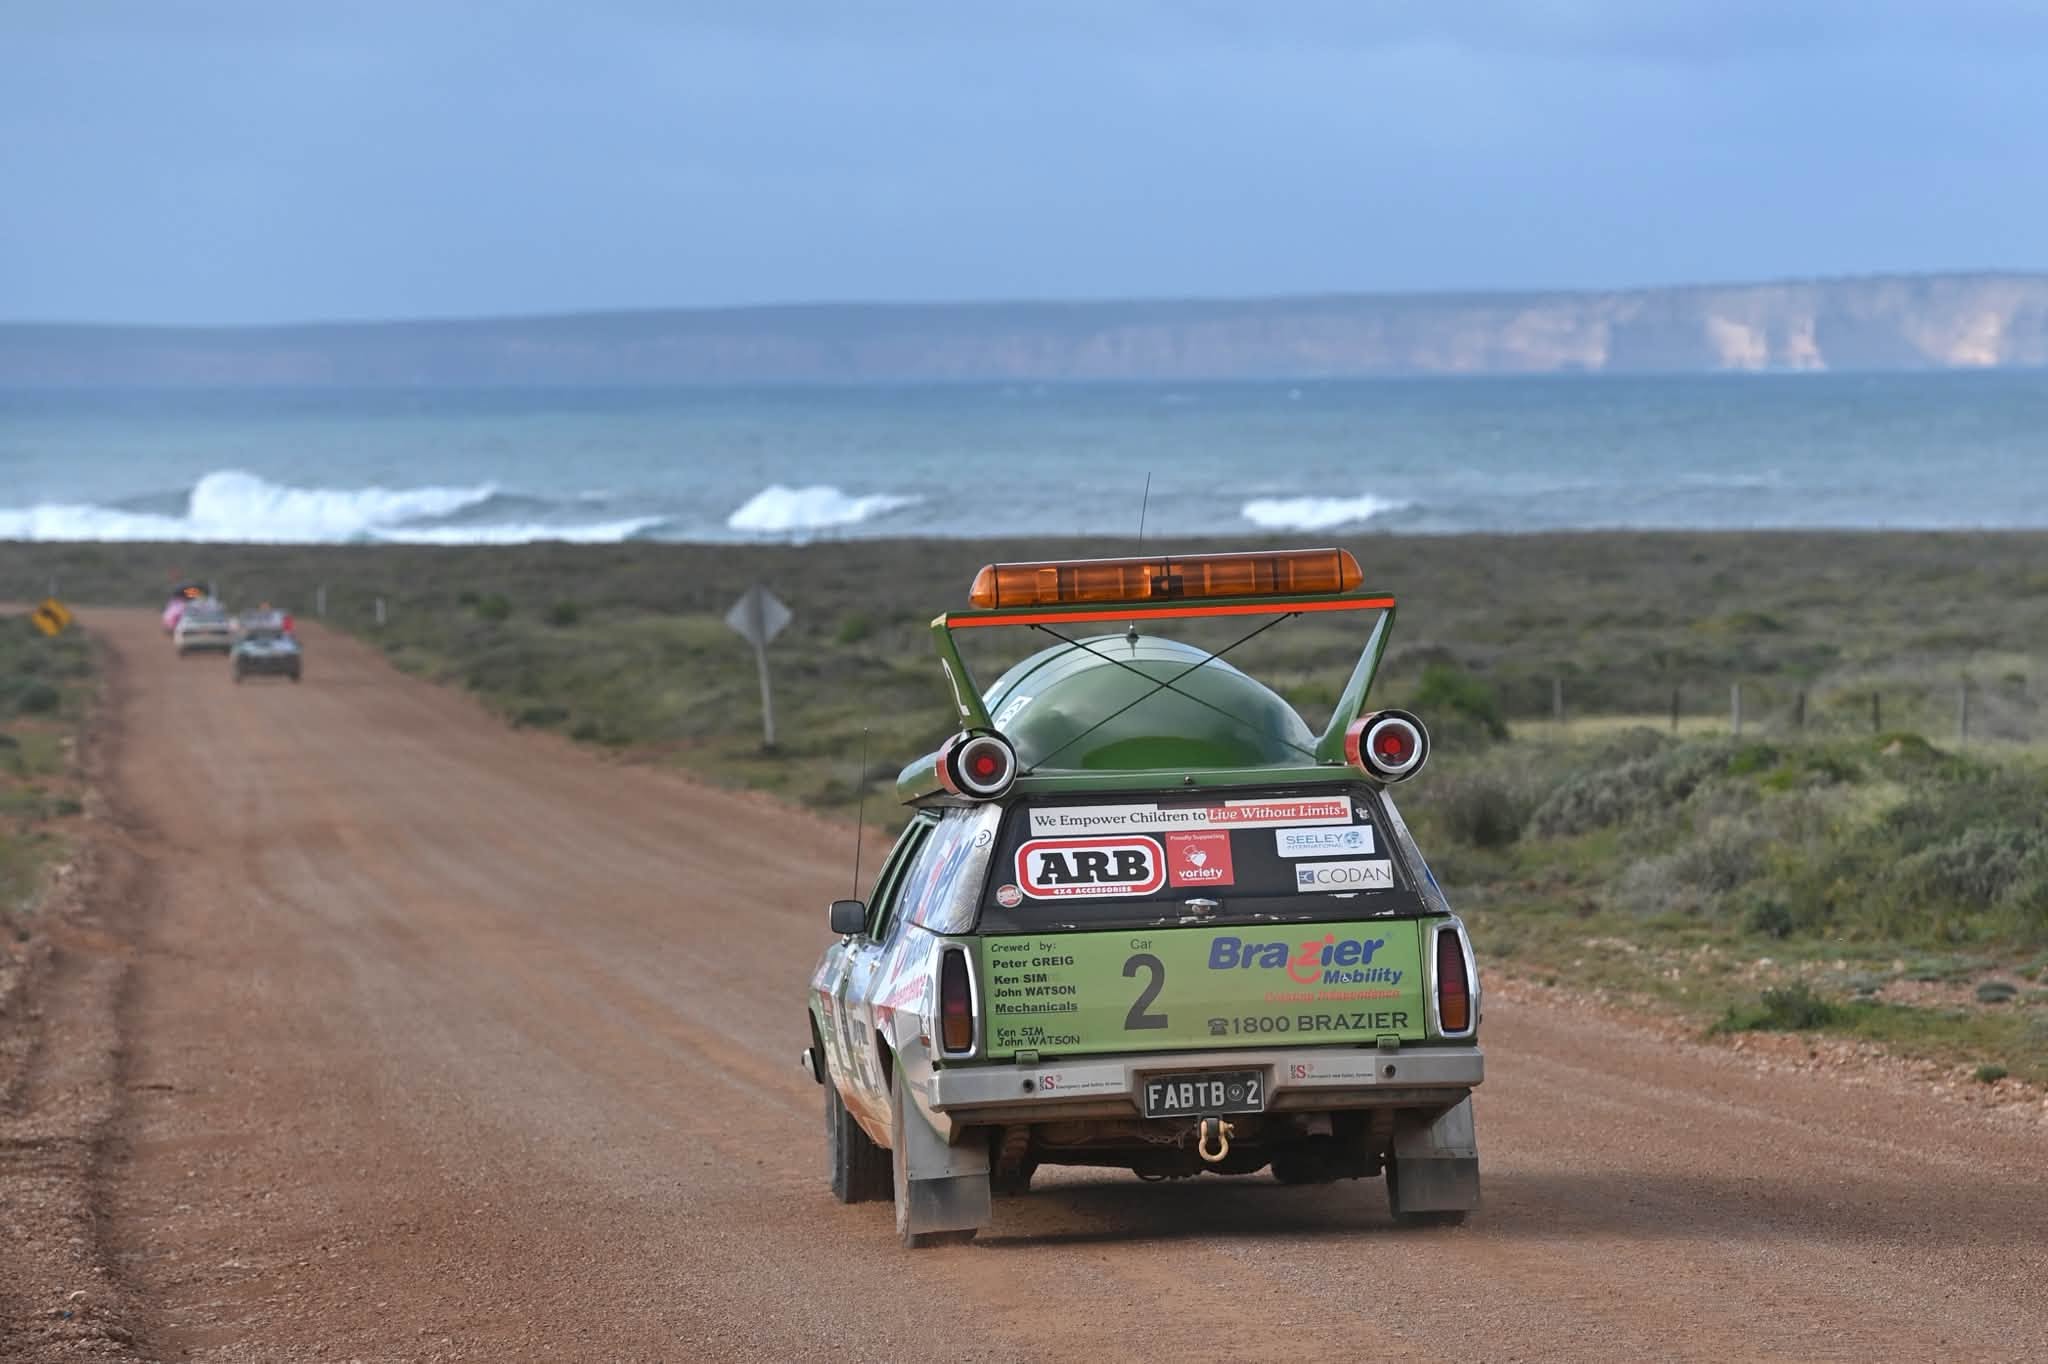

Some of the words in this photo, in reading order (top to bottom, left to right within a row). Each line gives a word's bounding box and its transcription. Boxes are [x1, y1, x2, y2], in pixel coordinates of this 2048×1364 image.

[1034, 815, 1057, 827] We
[1060, 814, 1127, 829] Empower
[1130, 811, 1190, 824] Children
[1192, 811, 1206, 821] to
[1209, 807, 1237, 820] Live
[1240, 806, 1296, 818] Without
[1299, 804, 1345, 817] Limits.
[1286, 833, 1343, 845] SEELEY
[1036, 850, 1150, 885] ARB
[1179, 867, 1223, 879] variety
[1316, 863, 1391, 884] CODAN
[1075, 885, 1132, 895] ACCESSORIES
[991, 942, 1030, 953] Crewed
[1039, 941, 1057, 952] by:
[1130, 938, 1153, 950] Car
[1207, 933, 1385, 978] Brazier
[992, 958, 1028, 969] Peter
[1031, 956, 1074, 967] GREIG
[994, 974, 1019, 985] Ken
[1023, 973, 1048, 984] SIM
[1323, 967, 1404, 985] Mobility
[994, 988, 1022, 998] John
[1025, 985, 1076, 997] WATSON
[1122, 953, 1168, 1031] 2
[995, 1001, 1079, 1014] Mechanicals
[1232, 1015, 1291, 1034] 1800
[1297, 1012, 1409, 1032] BRAZIER
[997, 1027, 1016, 1038] Ken
[1021, 1026, 1045, 1037] SIM
[997, 1036, 1024, 1047] John
[1027, 1035, 1081, 1047] WATSON
[1149, 1081, 1225, 1110] FABTB
[1246, 1080, 1260, 1105] 2
